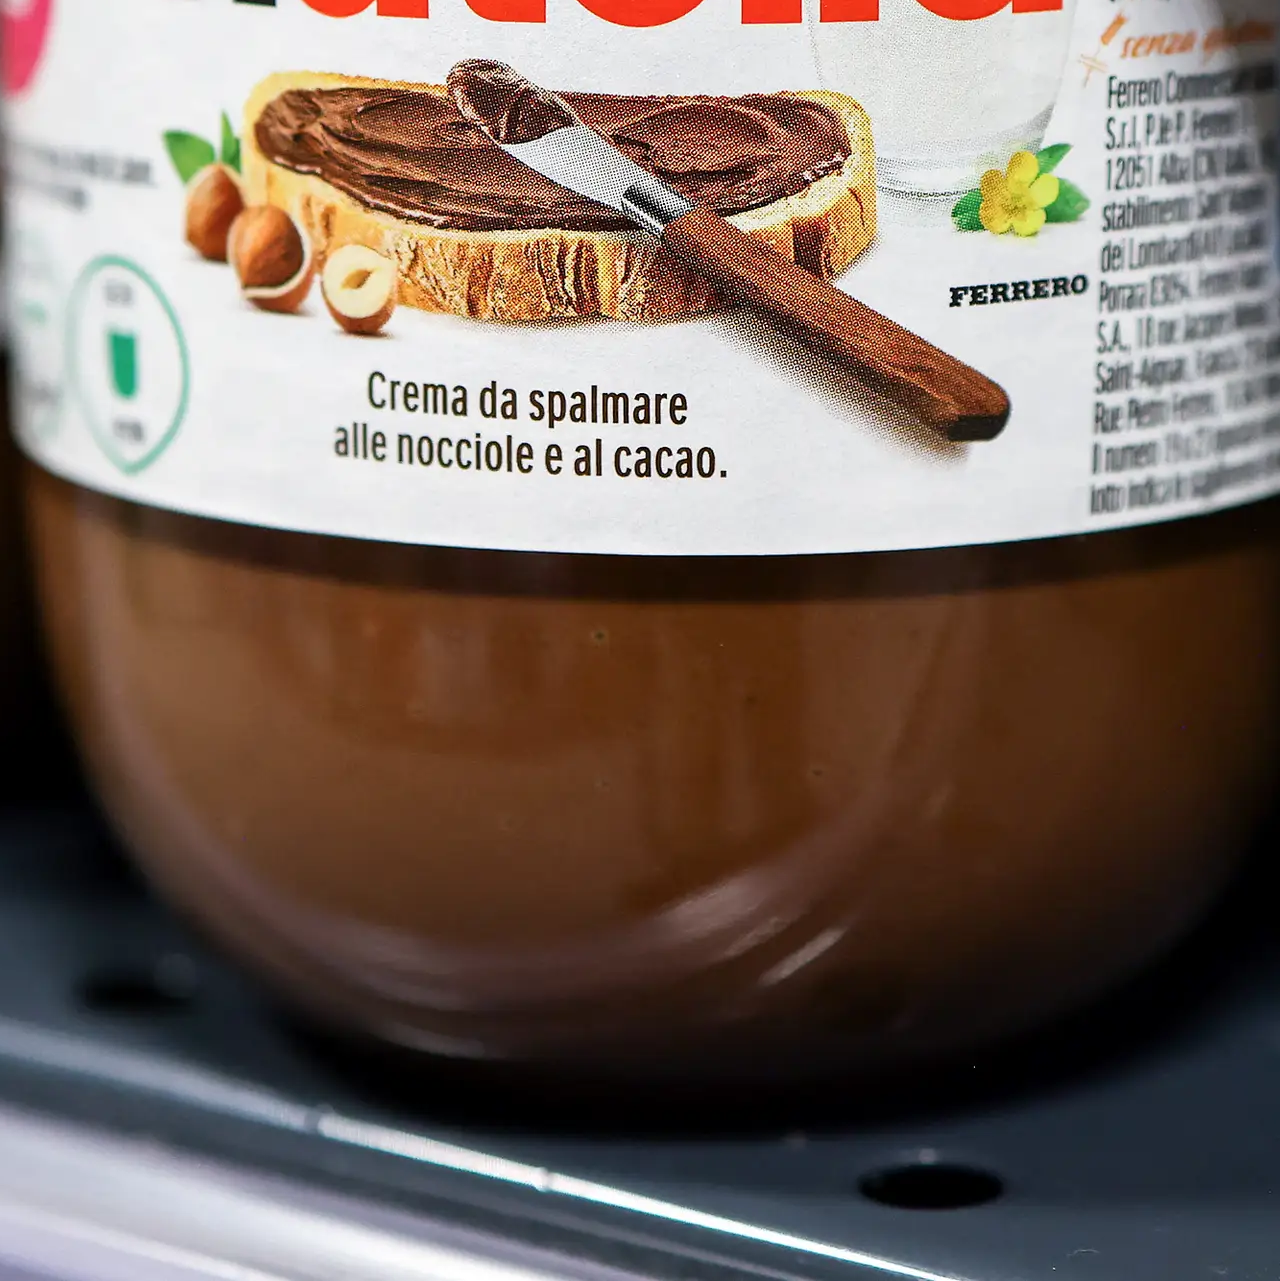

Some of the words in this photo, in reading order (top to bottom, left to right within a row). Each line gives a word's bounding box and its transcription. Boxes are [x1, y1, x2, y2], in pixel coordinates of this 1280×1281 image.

[1120, 29, 1197, 59] senza
[1107, 74, 1163, 109] Ferrero
[1106, 154, 1154, 191] 12051
[1101, 239, 1125, 273] dei
[949, 275, 1090, 308] FERRERO
[368, 370, 468, 417] Crema
[479, 380, 518, 420] da
[529, 384, 688, 428] spalmare
[334, 422, 388, 462] alle
[398, 432, 535, 474] nocciole
[545, 442, 563, 474] e
[574, 438, 602, 477] al
[614, 444, 728, 479] cacao.
